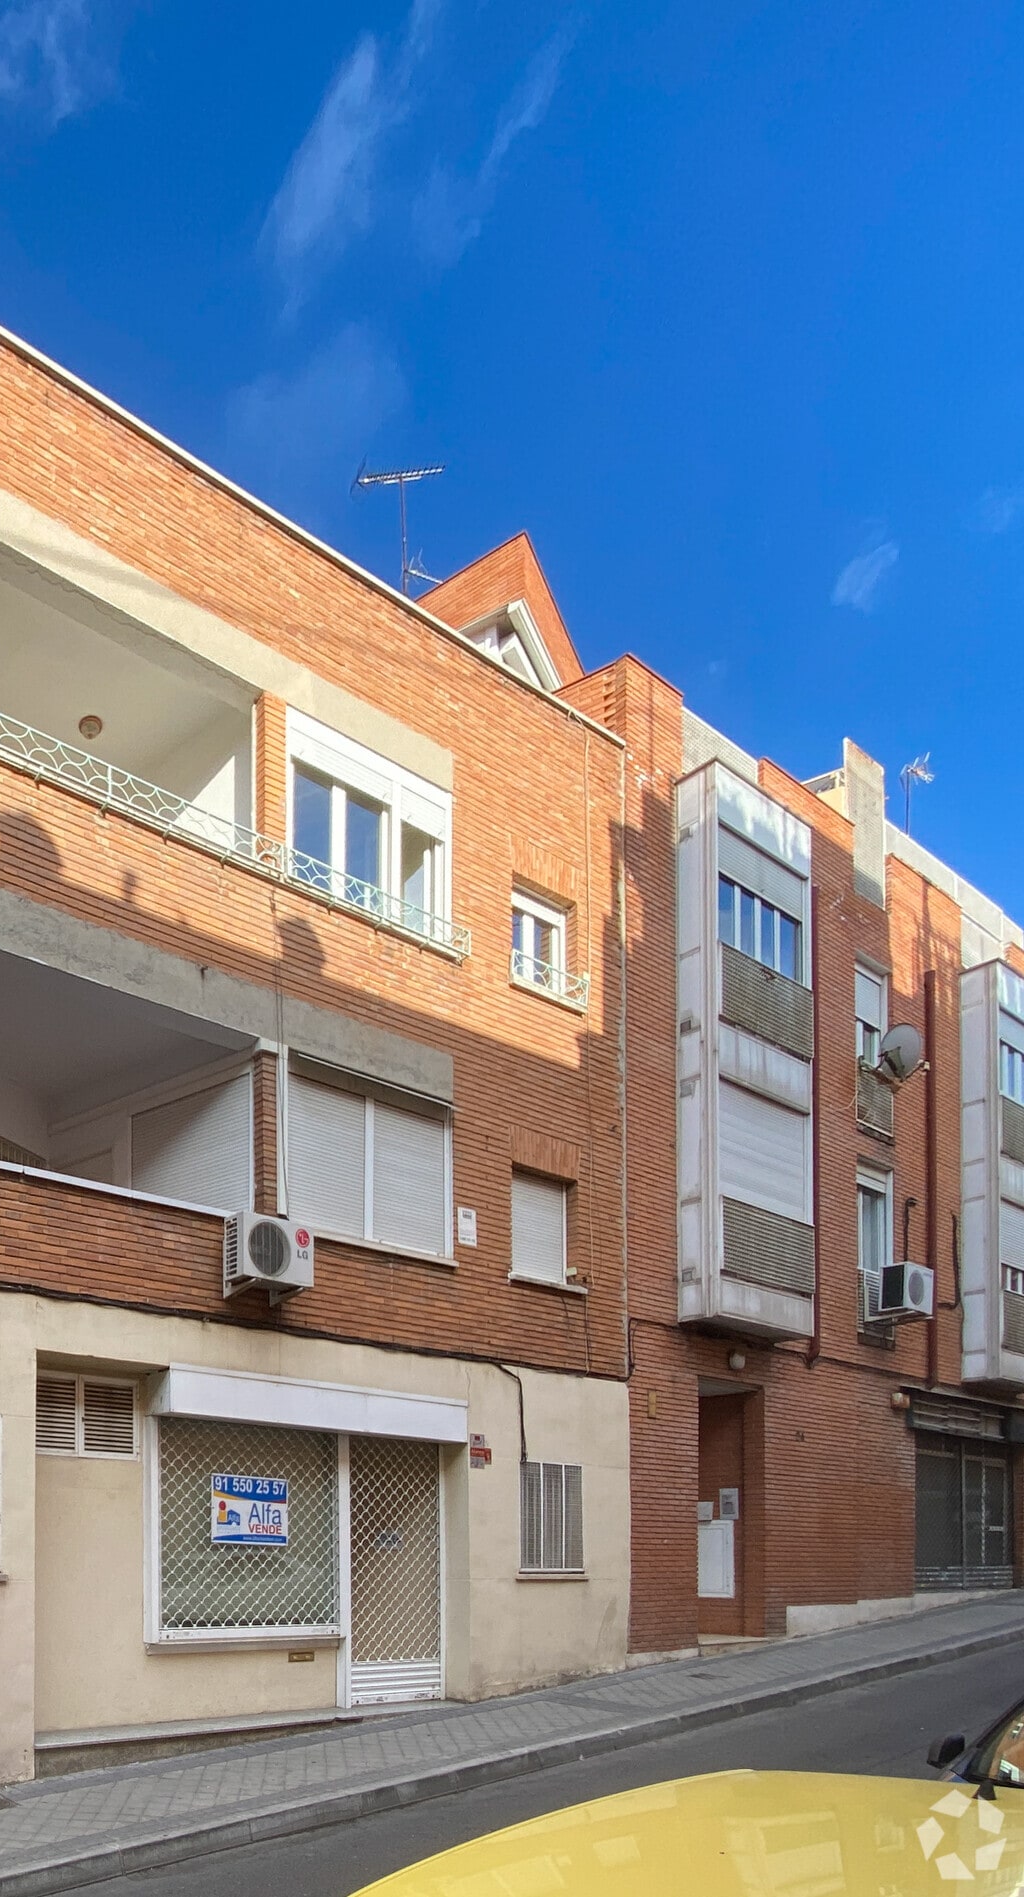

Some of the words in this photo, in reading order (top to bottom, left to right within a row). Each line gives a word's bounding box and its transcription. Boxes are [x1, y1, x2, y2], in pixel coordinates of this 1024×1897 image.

[297, 1249, 308, 1260] LG
[215, 1476, 228, 1491] 91
[233, 1478, 253, 1493] 550
[256, 1480, 270, 1494] 25
[272, 1481, 286, 1496] 57
[248, 1502, 282, 1525] Alfa
[248, 1524, 282, 1535] VENDE
